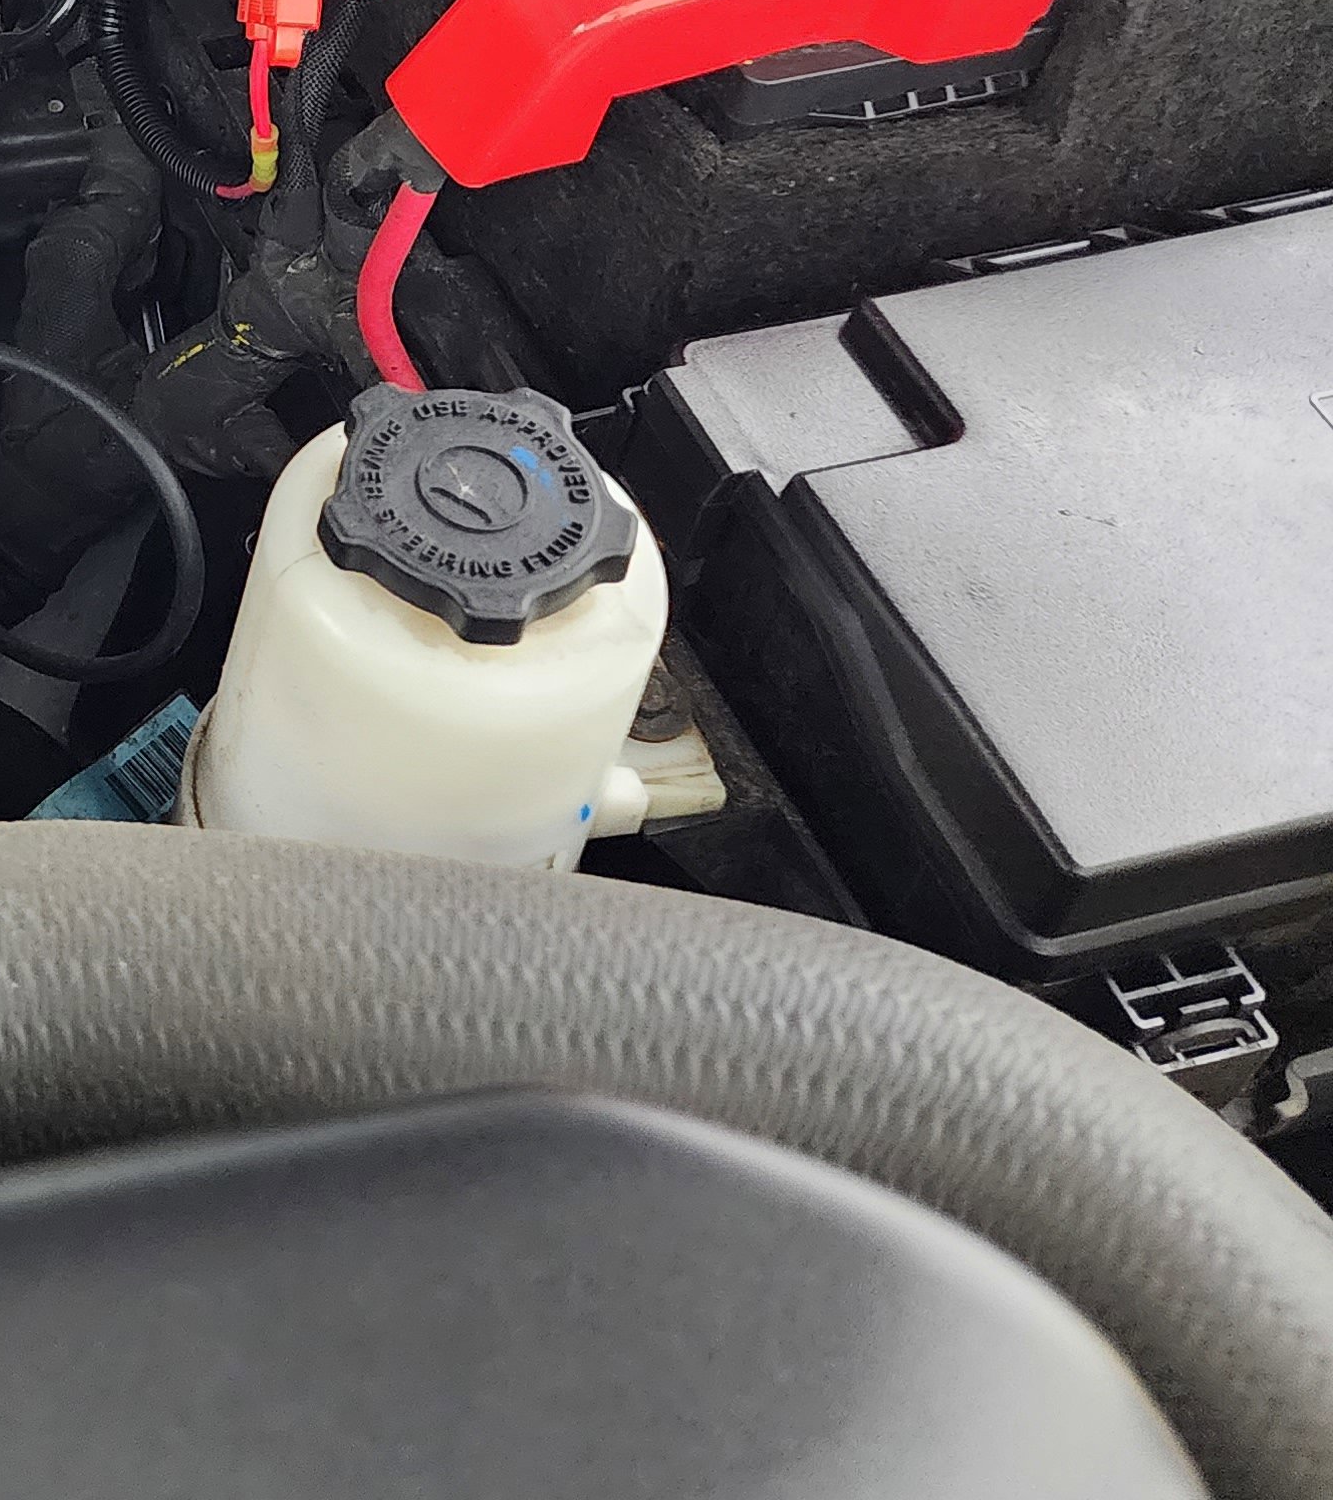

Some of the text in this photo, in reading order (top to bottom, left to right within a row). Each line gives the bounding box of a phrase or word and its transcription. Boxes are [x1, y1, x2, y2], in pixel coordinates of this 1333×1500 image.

[358, 418, 584, 579] POWER STEERING FLUID
[412, 398, 592, 506] USE APPROVED
